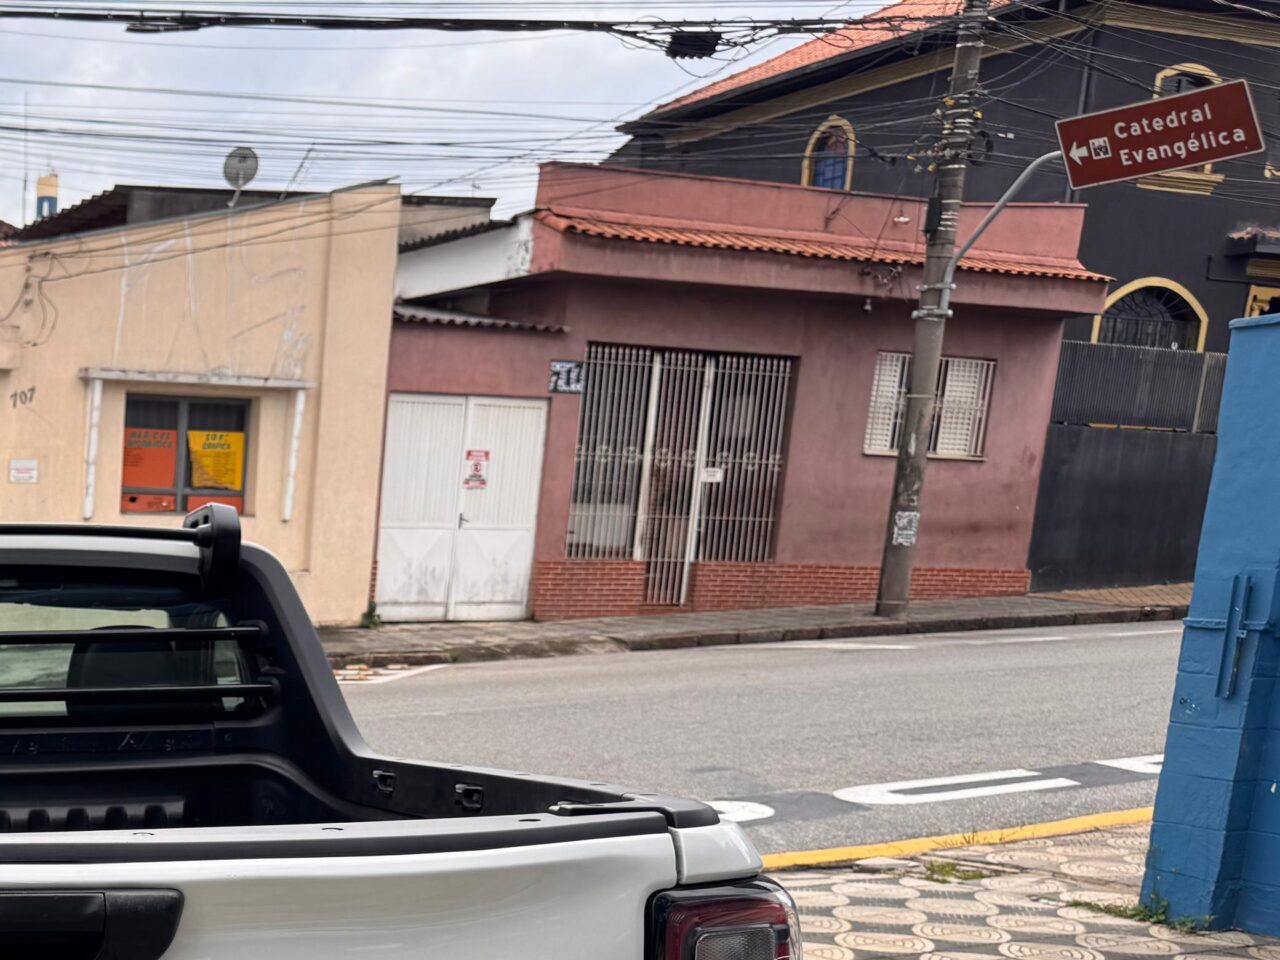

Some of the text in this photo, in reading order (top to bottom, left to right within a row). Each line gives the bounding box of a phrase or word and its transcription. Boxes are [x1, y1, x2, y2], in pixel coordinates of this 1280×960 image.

[1113, 103, 1212, 139] Catedral
[1119, 128, 1246, 166] Evangélica
[10, 385, 36, 408] 707
